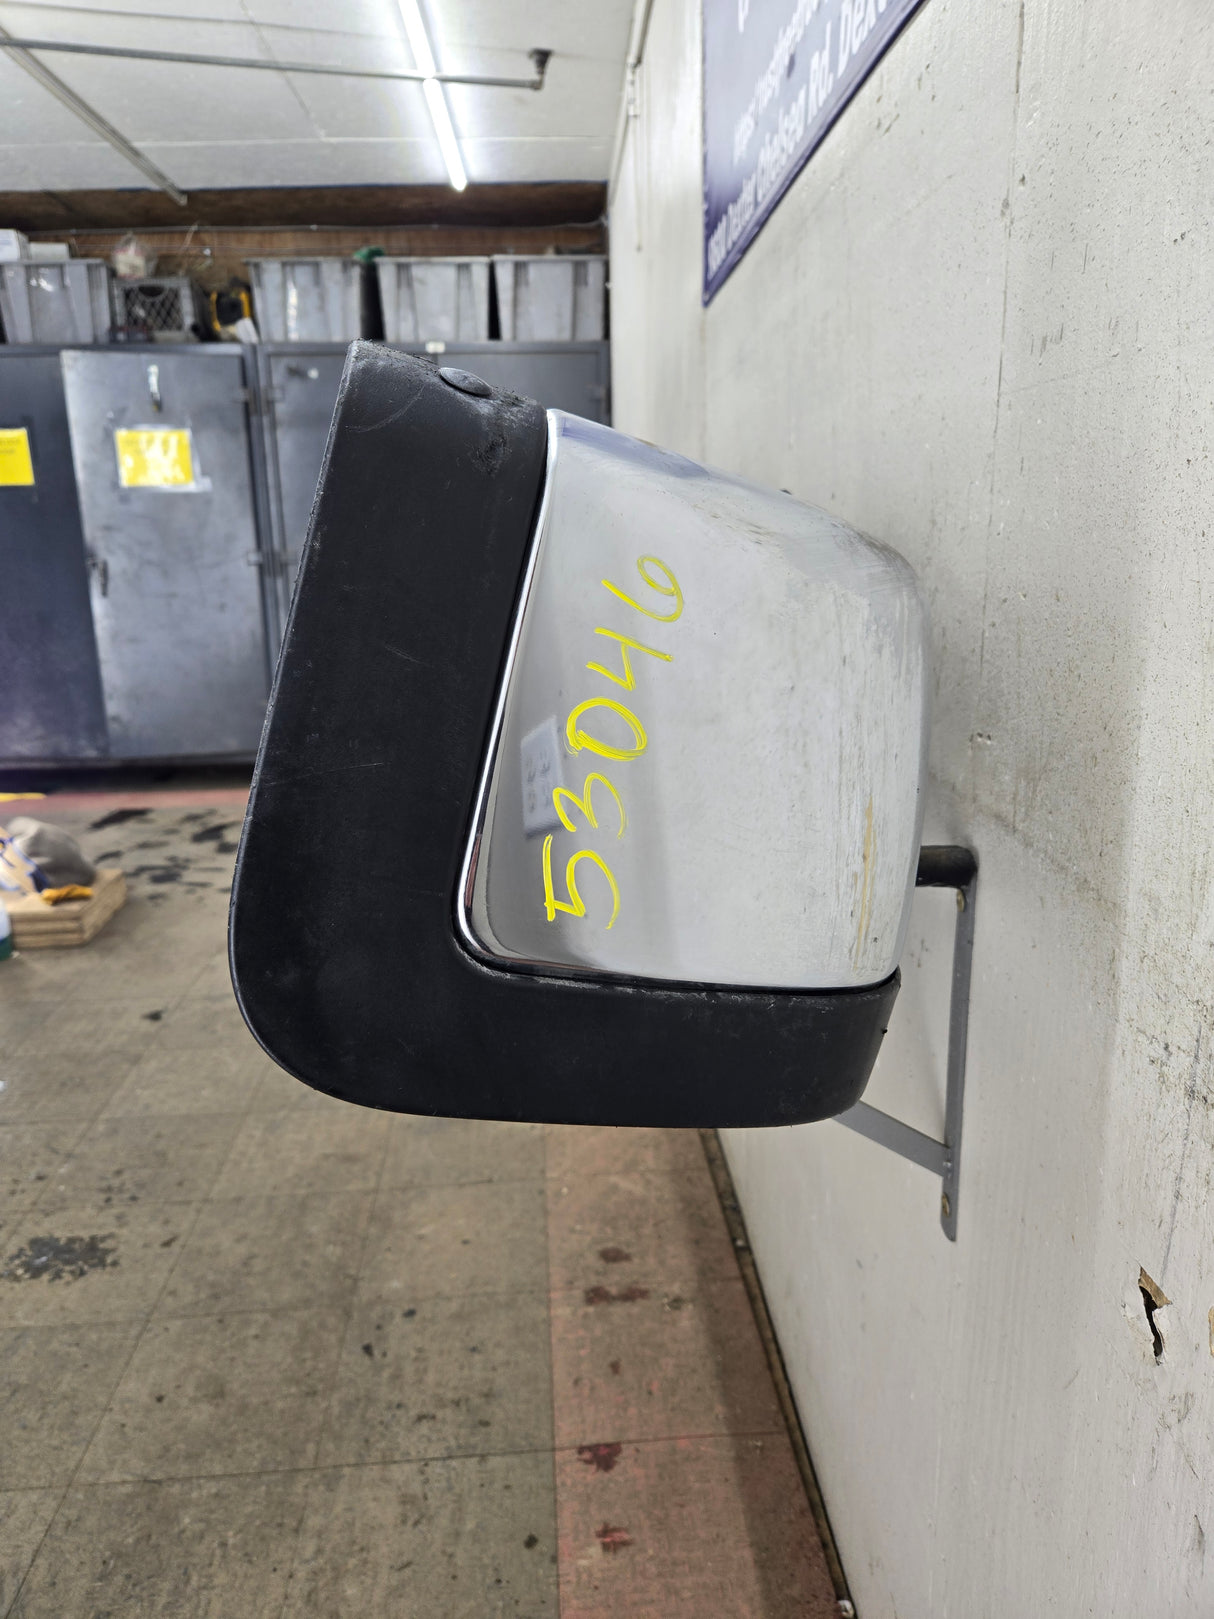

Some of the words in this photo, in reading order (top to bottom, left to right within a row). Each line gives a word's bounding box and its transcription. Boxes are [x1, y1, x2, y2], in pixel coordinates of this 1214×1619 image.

[757, 84, 807, 202] Chelsea
[807, 20, 834, 125] Rd.
[838, 0, 887, 78] Dex
[543, 556, 683, 930] 53046
